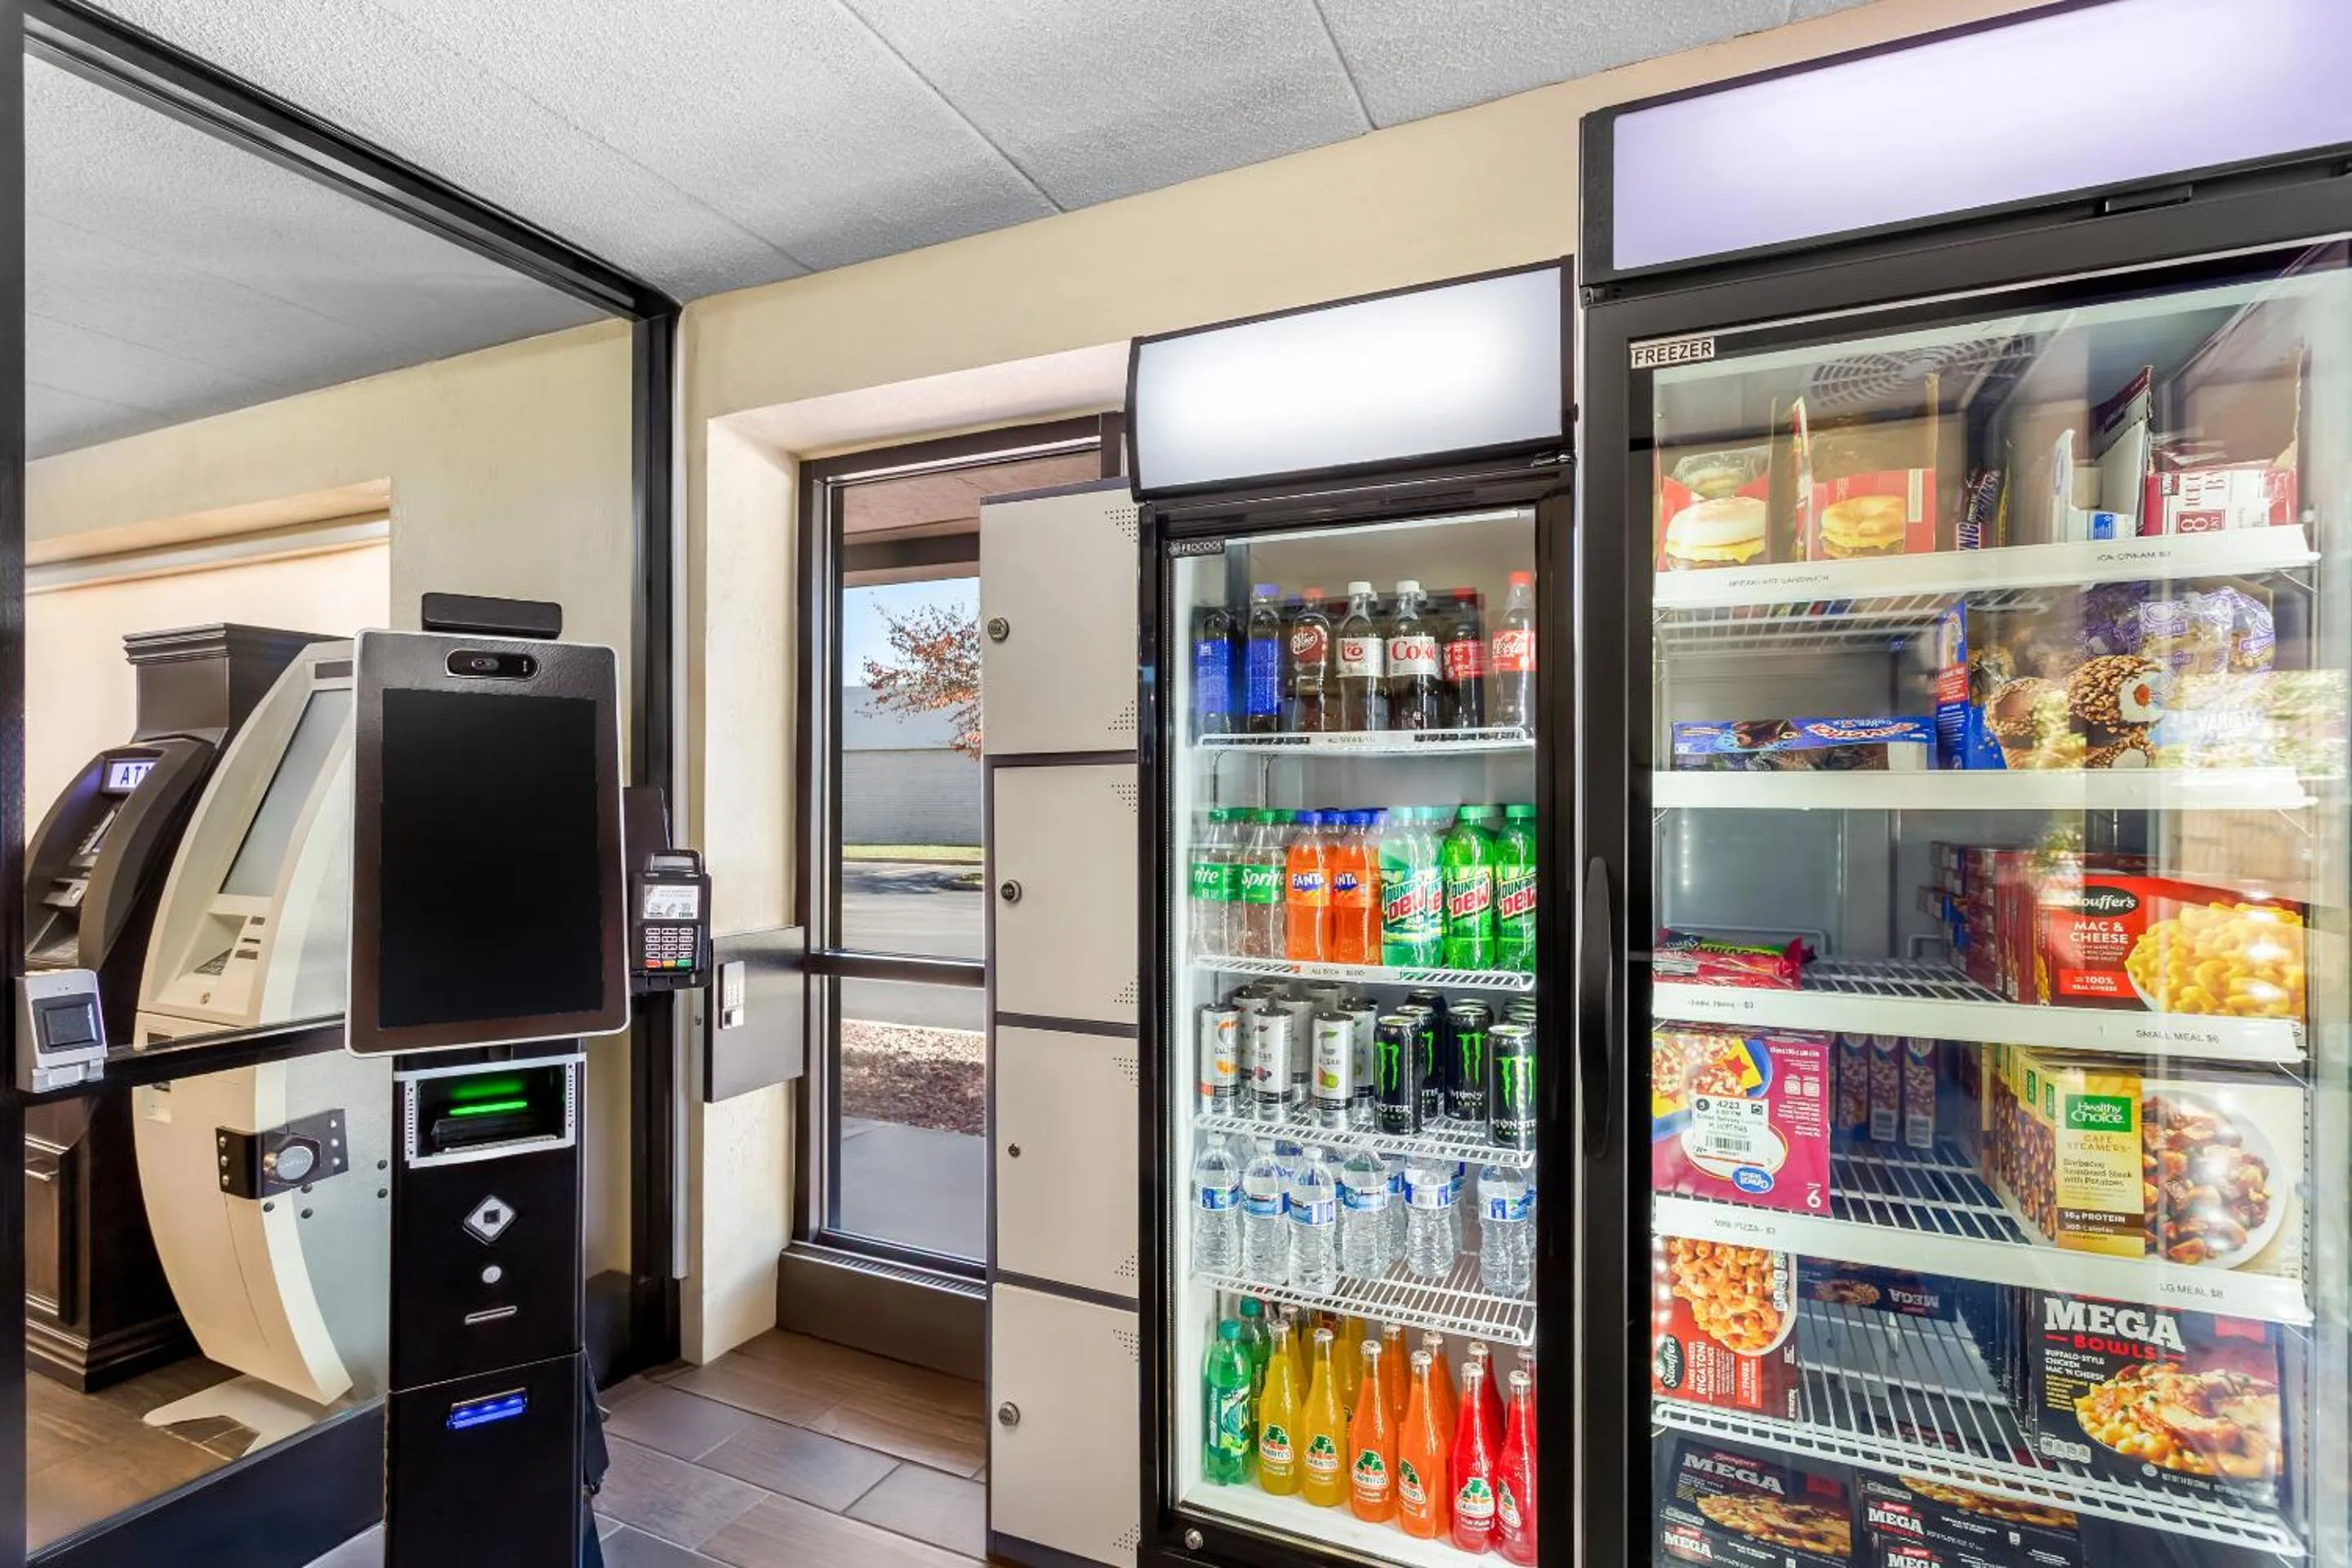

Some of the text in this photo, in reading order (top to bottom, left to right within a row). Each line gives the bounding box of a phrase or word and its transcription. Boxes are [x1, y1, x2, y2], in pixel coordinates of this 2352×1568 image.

[1635, 341, 1712, 365] FREEZER
[120, 765, 149, 784] AT
[2074, 921, 2123, 931] MAC &
[2069, 932, 2129, 944] CHEESE
[2084, 976, 2114, 985] 100%
[2136, 1029, 2172, 1040] SMALL
[2174, 1032, 2204, 1042] MEAL
[2071, 1111, 2125, 1124] Choice
[2077, 1102, 2122, 1114] Healthy
[1806, 1190, 1821, 1209] 6
[2082, 1212, 2125, 1223] PROTEIN
[1889, 1288, 1940, 1308] MEGA
[2044, 1297, 2186, 1353] MEGA
[2074, 1334, 2158, 1361] BOWLS
[1696, 1342, 1707, 1394] RIGATONI
[1682, 1453, 1785, 1495] MEGA
[1869, 1507, 1925, 1535] MEGA
[1664, 1530, 1713, 1560] MEGA
